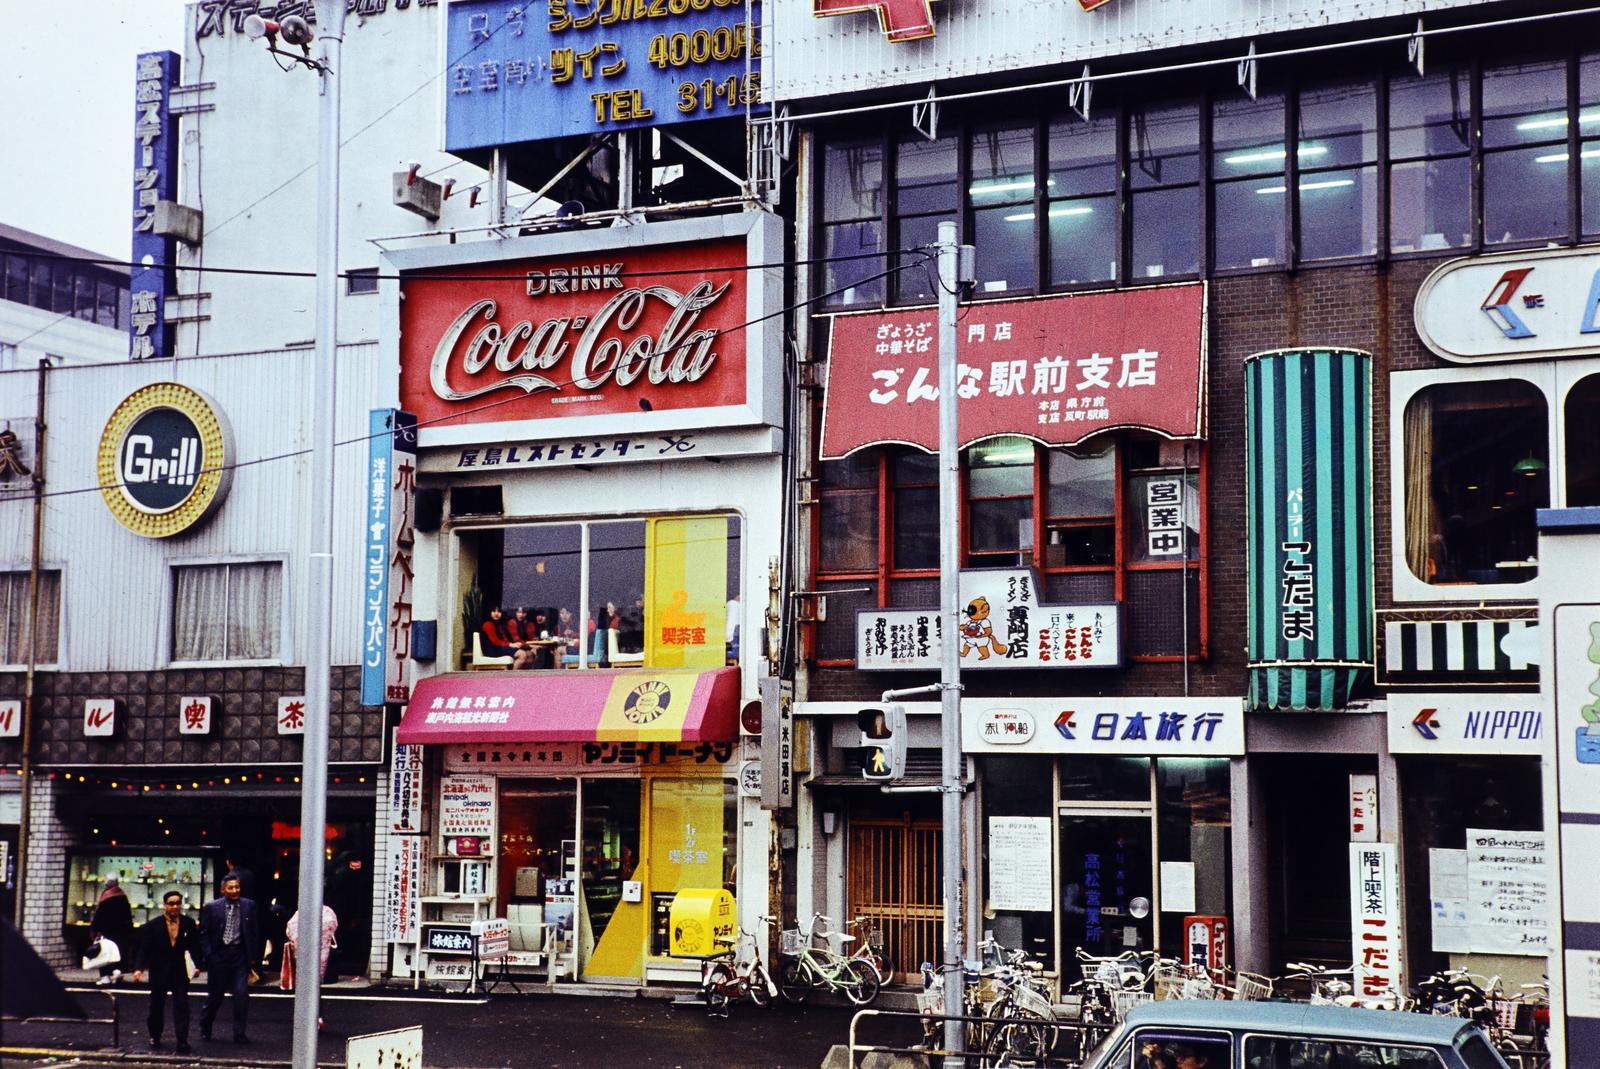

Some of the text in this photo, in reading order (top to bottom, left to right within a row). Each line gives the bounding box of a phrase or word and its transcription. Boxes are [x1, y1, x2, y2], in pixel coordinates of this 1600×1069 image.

[550, 41, 627, 83] ツイン
[591, 88, 653, 123] TEL
[527, 262, 624, 296] DRINK
[131, 289, 158, 359] ホテル
[429, 279, 733, 401] Coca-Cola
[875, 337, 933, 355] 中華そば
[877, 322, 932, 339] ぎょうざ
[1038, 400, 1060, 411] 本店
[1038, 411, 1060, 424] 支店
[124, 434, 198, 486] Grill
[457, 439, 645, 469] 屋島レストセンター
[371, 457, 386, 518] 洋菓子
[1149, 482, 1183, 553] 営業中
[389, 457, 416, 684] ホームベーカリー
[1282, 541, 1314, 641] こだま
[661, 627, 706, 645] 喫茶室
[1005, 606, 1030, 659] 専門店
[1091, 711, 1224, 742] 日本旅行
[1084, 853, 1101, 942] 高松営業所
[1363, 851, 1383, 914] 階上喫茶
